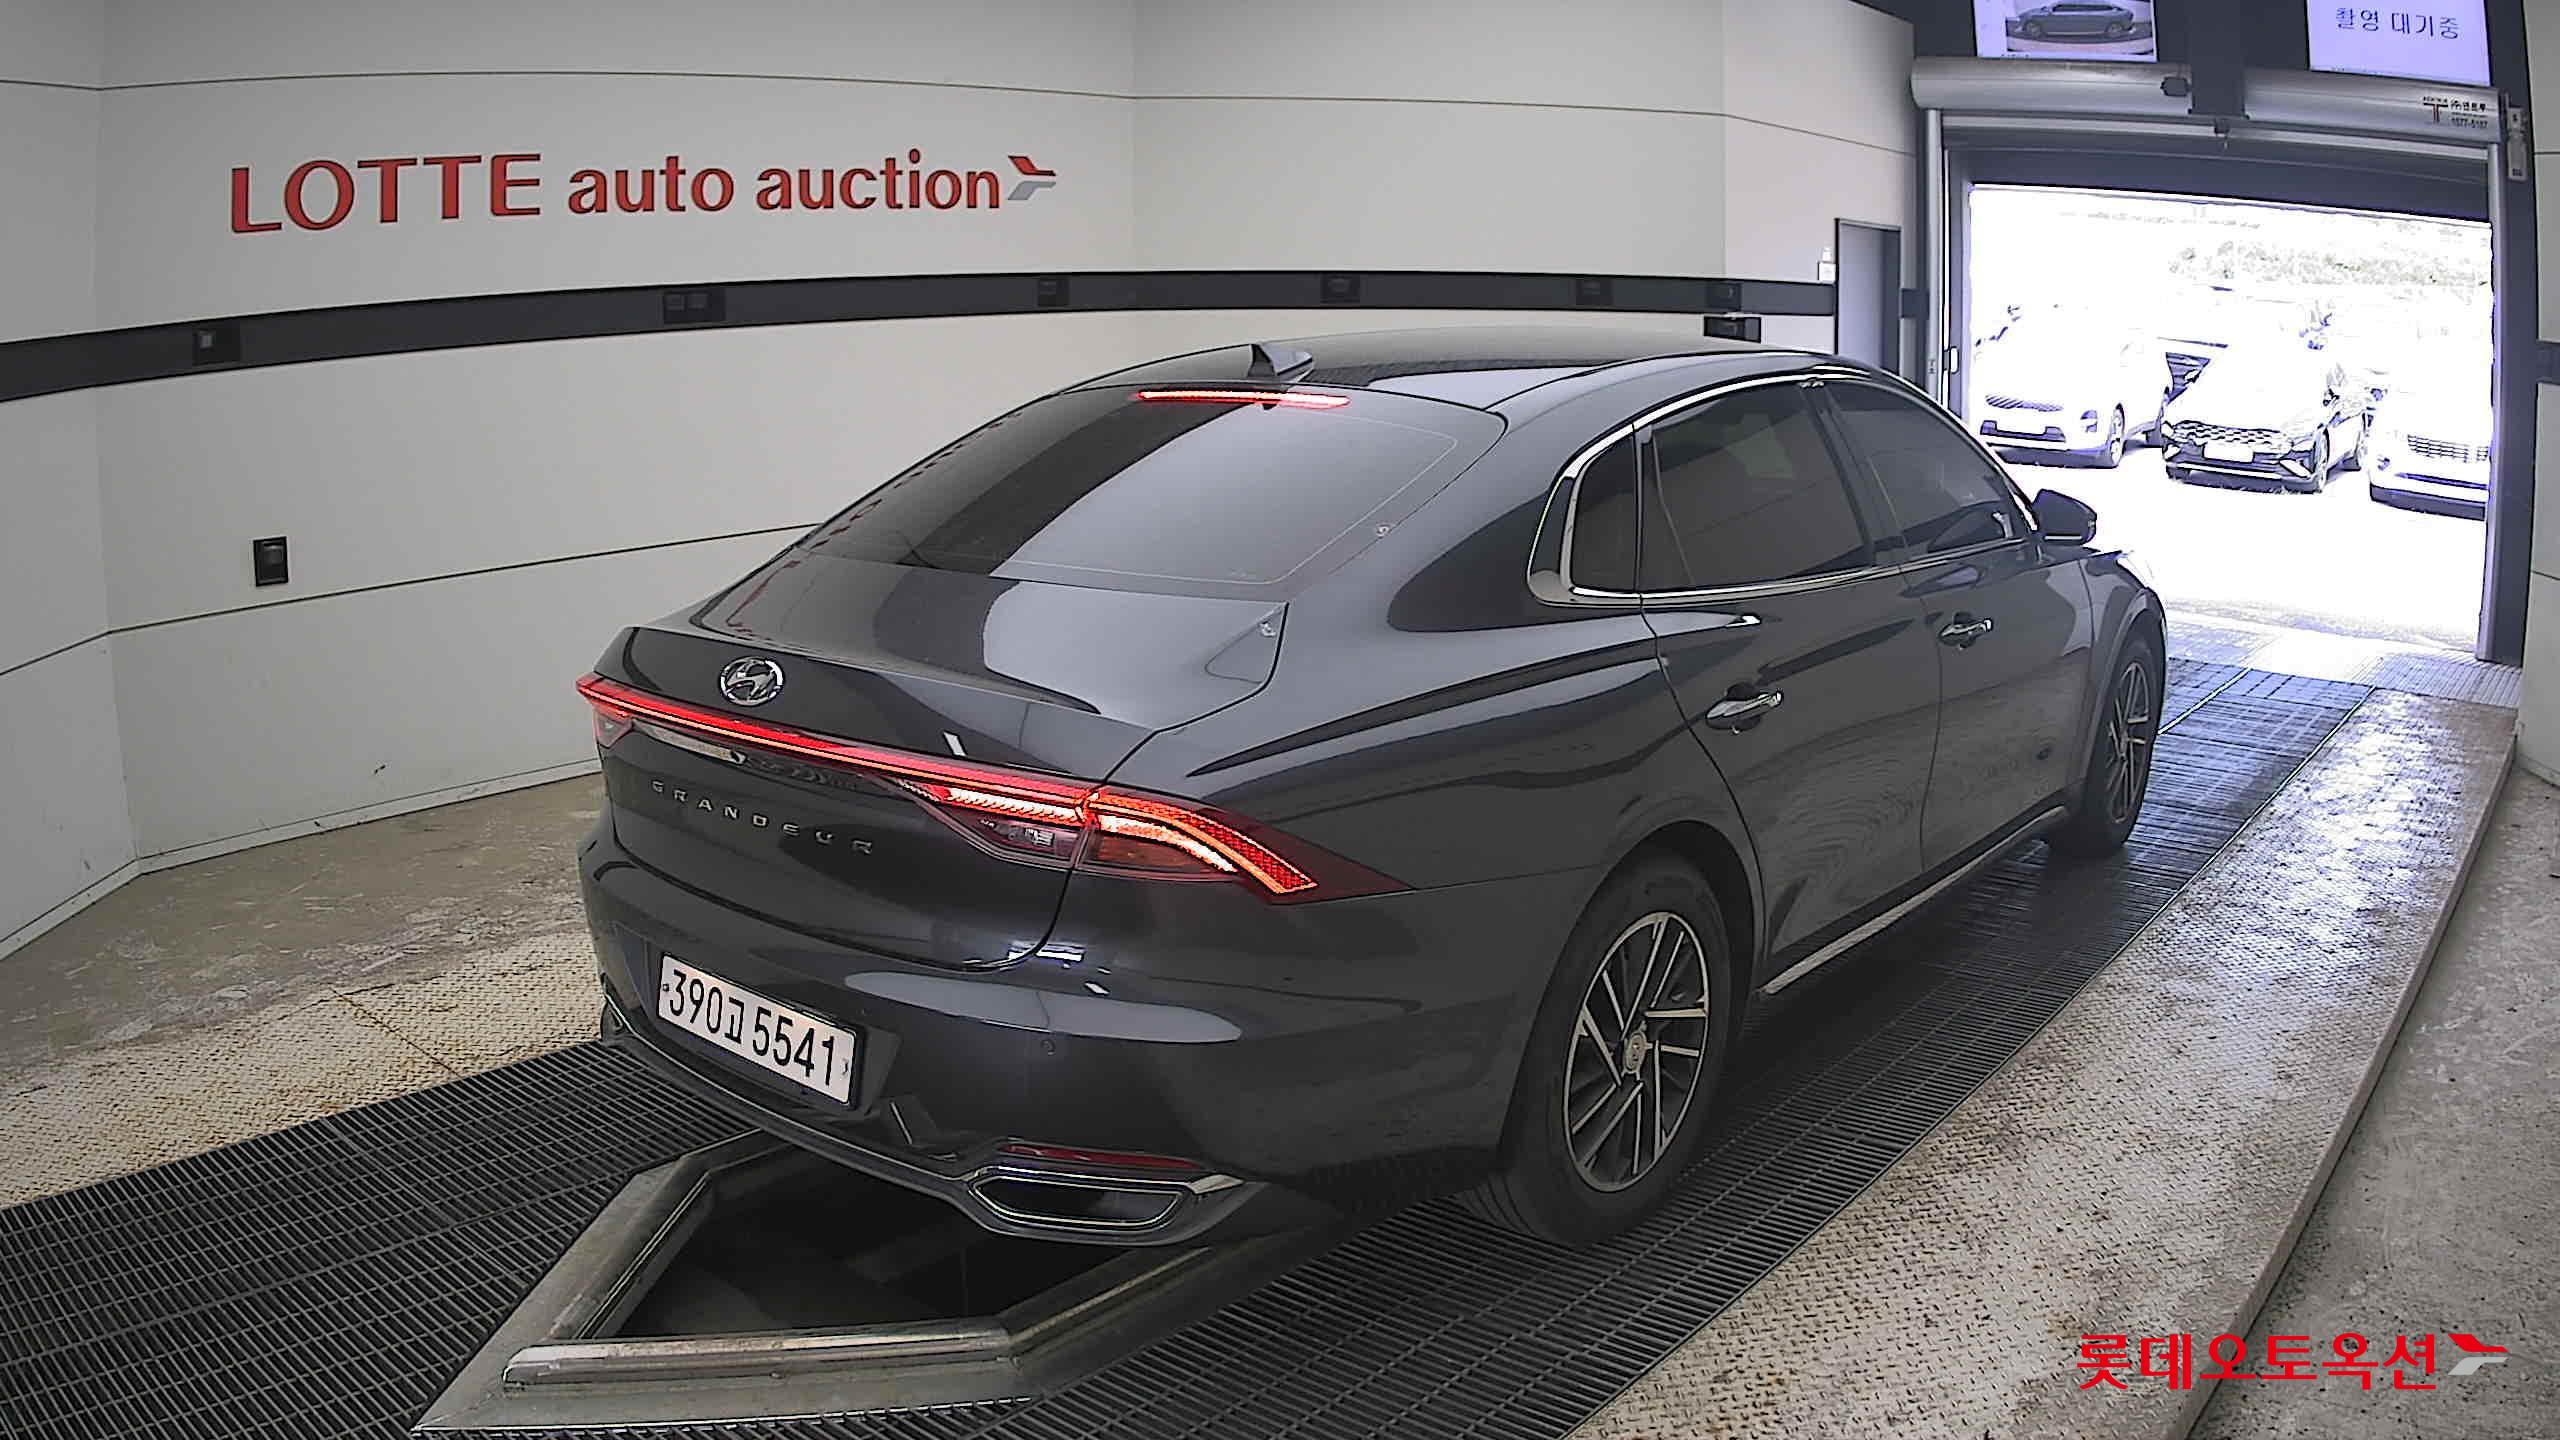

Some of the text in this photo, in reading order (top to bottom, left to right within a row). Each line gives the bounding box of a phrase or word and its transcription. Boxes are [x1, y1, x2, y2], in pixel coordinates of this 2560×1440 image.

[2336, 8, 2458, 39] 촬영 대기중
[231, 148, 1002, 233] LOTTE auto auction
[651, 780, 873, 855] GRANDEUR
[669, 969, 835, 1087] 390고 5541
